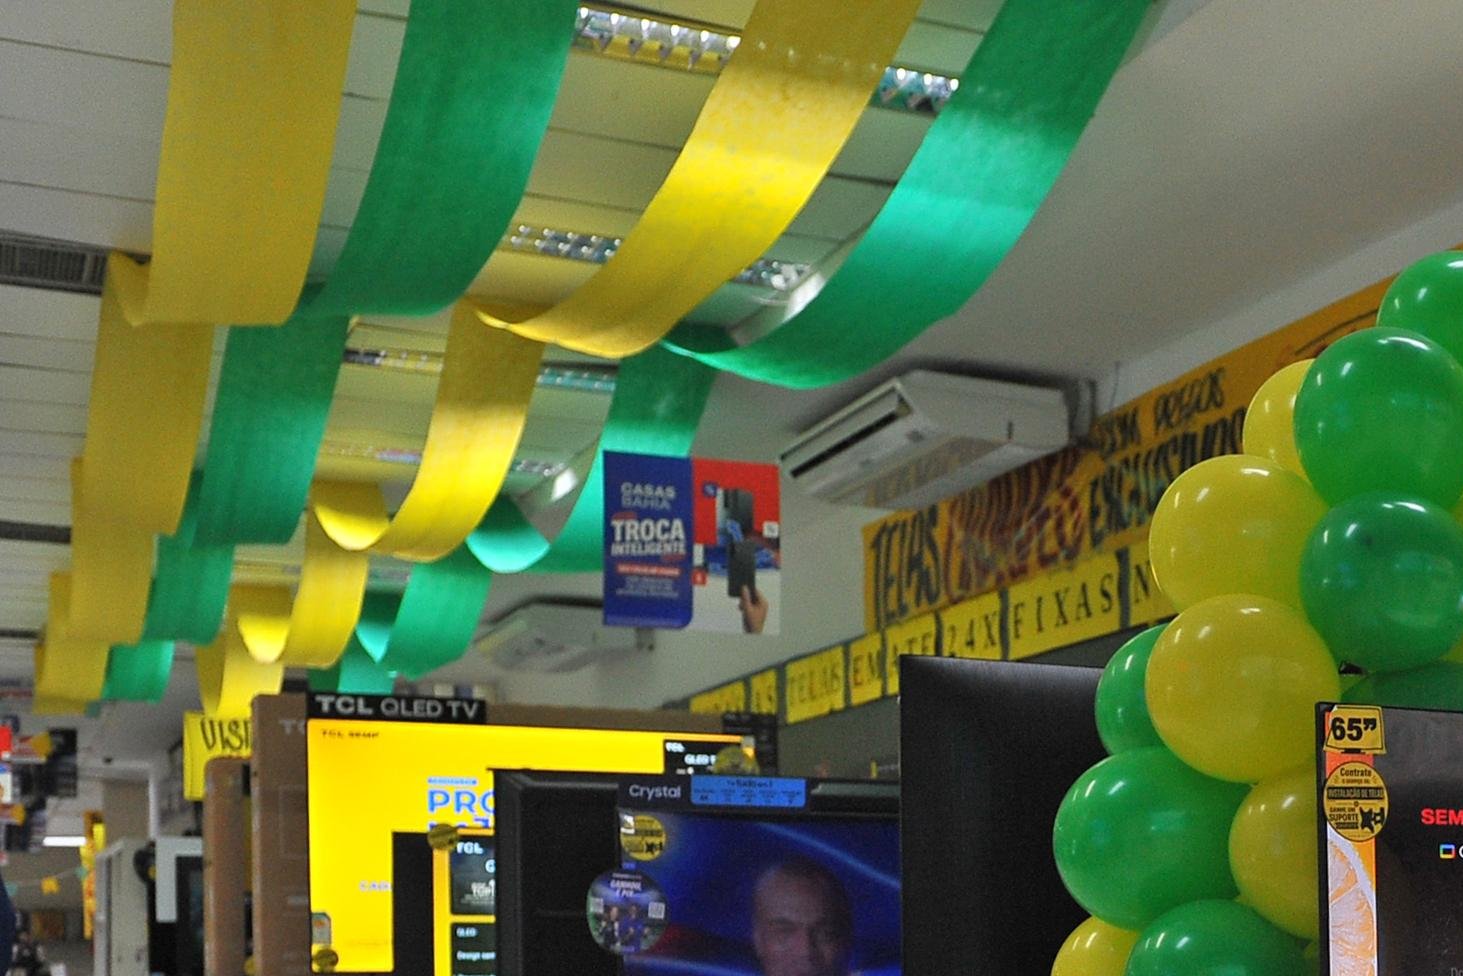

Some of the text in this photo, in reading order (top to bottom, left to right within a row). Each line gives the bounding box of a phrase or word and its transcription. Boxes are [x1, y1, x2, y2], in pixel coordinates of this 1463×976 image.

[620, 482, 676, 499] CASAS
[621, 496, 671, 510] BAHIA
[611, 518, 685, 542] TROCA
[611, 541, 686, 557] INTELIGENTE
[1013, 573, 1114, 639] FIXAS
[315, 694, 479, 719] TCL QLED TV
[1339, 767, 1372, 777] Contrate
[628, 784, 682, 801] Crystal
[1328, 813, 1359, 821] SUPORTE
